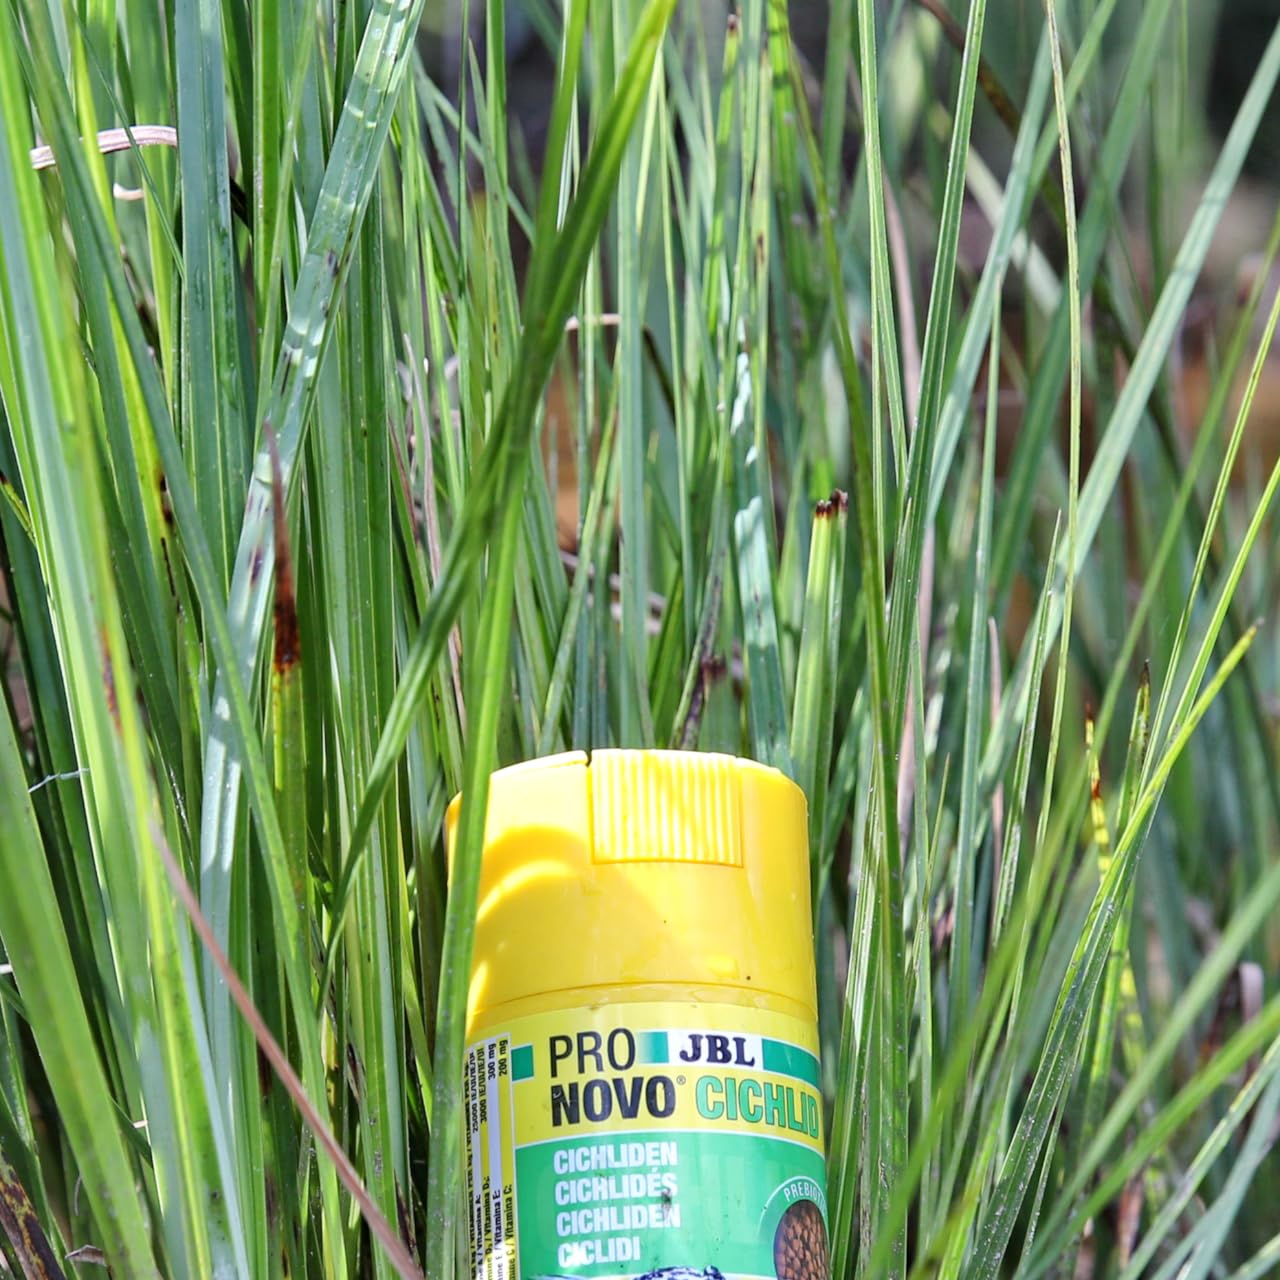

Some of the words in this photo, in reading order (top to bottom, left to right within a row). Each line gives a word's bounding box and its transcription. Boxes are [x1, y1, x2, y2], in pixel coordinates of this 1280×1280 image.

[488, 1043, 496, 1059] mg
[499, 1040, 508, 1055] mg
[549, 1028, 636, 1078] PRO
[679, 1034, 755, 1066] JBL
[488, 1061, 496, 1080] 300
[498, 1058, 508, 1076] 200
[695, 1075, 819, 1140] CICHLID
[553, 1141, 679, 1175] CICHLIDEN
[554, 1166, 679, 1206] CICHLIDÉS
[504, 1196, 514, 1240] Vitamina
[556, 1203, 681, 1237] CICHLIDEN
[557, 1235, 641, 1268] CICLIDI
